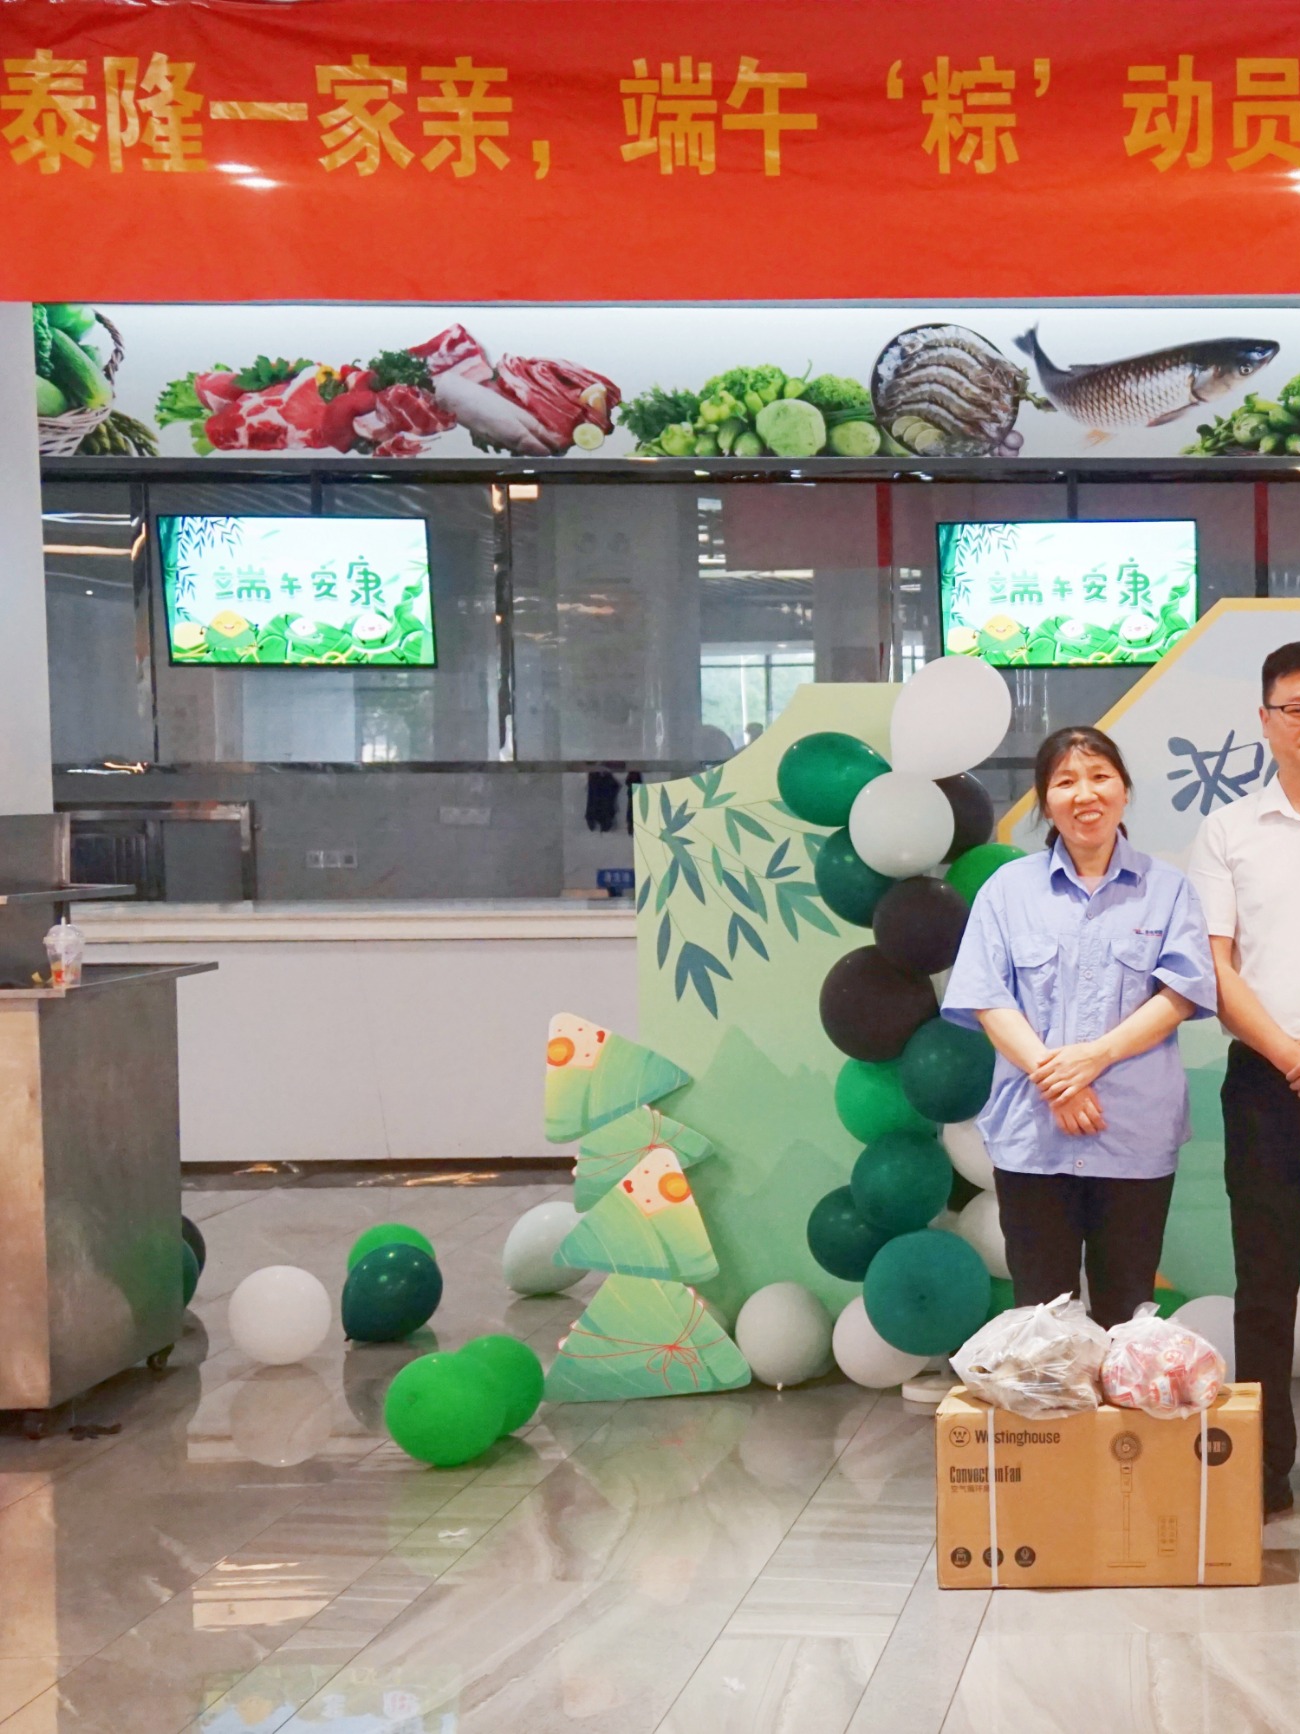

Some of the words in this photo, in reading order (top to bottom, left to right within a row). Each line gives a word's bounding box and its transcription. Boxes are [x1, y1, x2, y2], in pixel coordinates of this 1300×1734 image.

[212, 555, 386, 606] 端午安康
[988, 557, 1153, 606] 端午安康
[975, 1429, 1061, 1447] Wstinghouse
